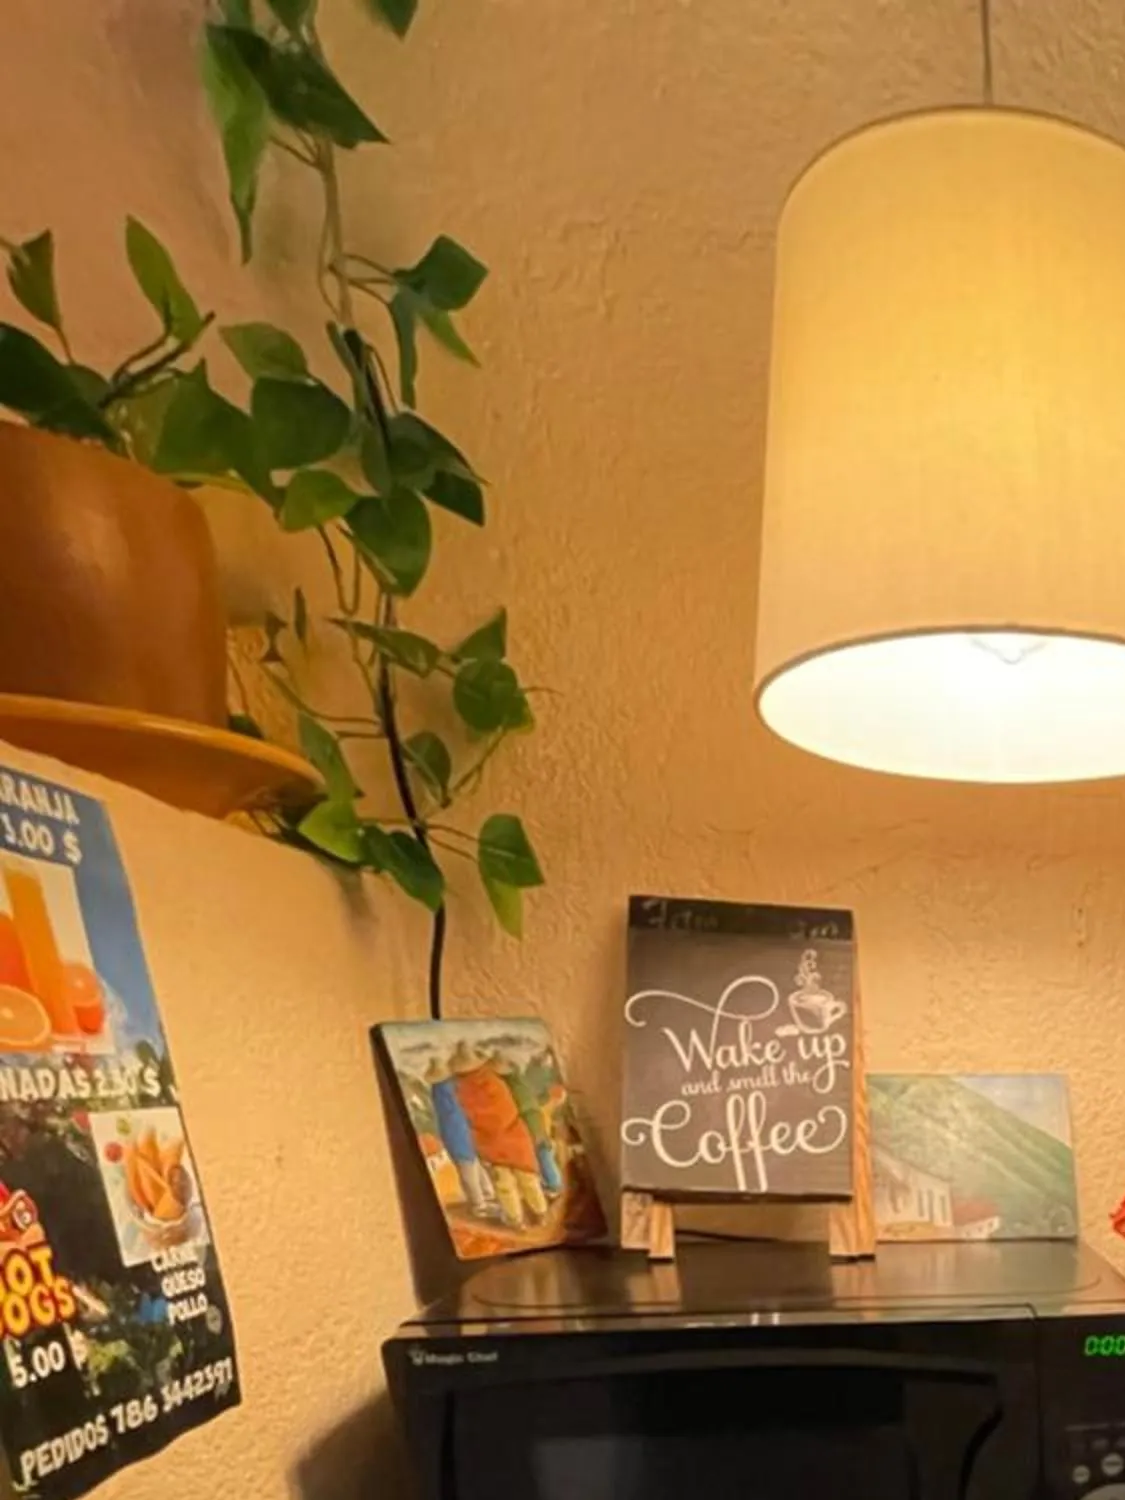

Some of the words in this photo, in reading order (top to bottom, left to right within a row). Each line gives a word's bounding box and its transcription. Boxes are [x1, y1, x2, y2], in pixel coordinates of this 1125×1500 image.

[681, 1070, 722, 1096] and
[726, 1066, 777, 1092] smell
[781, 1062, 813, 1084] the
[798, 1033, 850, 1094] up
[620, 1090, 847, 1193] Coffee
[0, 1246, 54, 1299] OT
[0, 1275, 76, 1335] OGS
[167, 1292, 208, 1325] POLLO
[9, 1341, 65, 1388] 5.00
[19, 1413, 109, 1486] PEDIDOS
[109, 1394, 159, 1434] 786
